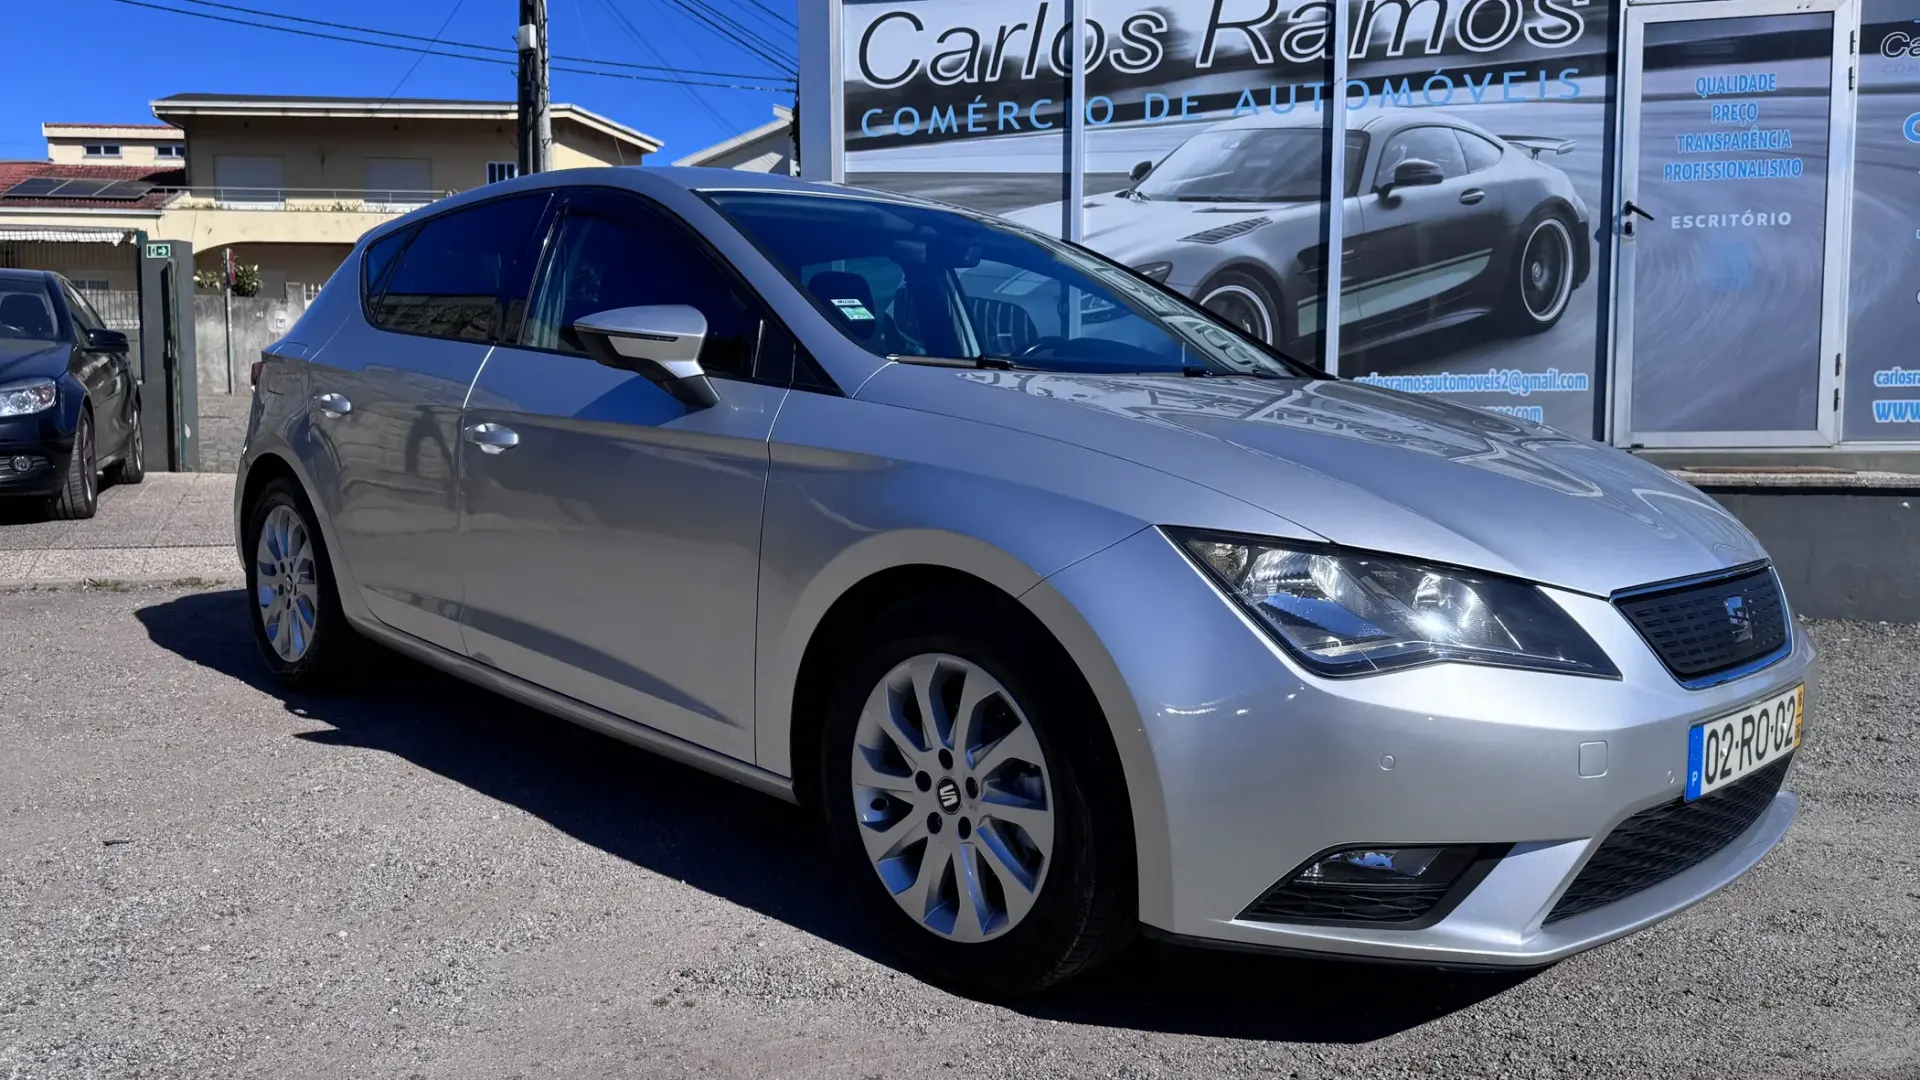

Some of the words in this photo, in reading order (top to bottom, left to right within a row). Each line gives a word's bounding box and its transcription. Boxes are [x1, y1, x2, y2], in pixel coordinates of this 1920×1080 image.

[858, 1, 1168, 89] Carlos
[1195, 0, 1589, 67] Ramos
[1145, 90, 1203, 122] DE
[1232, 68, 1582, 116] AUTOMÓVEIS
[1695, 73, 1776, 98] QUALIDADE
[1711, 102, 1758, 126] PREÇO
[1677, 125, 1792, 153] TRANSPARÊNCIA
[1663, 157, 1804, 182] PROFISSIONALISMO
[1671, 209, 1792, 229] ESCRITÓRIO
[1705, 695, 1795, 784] 02-RO-02
[1691, 771, 1699, 787] P
